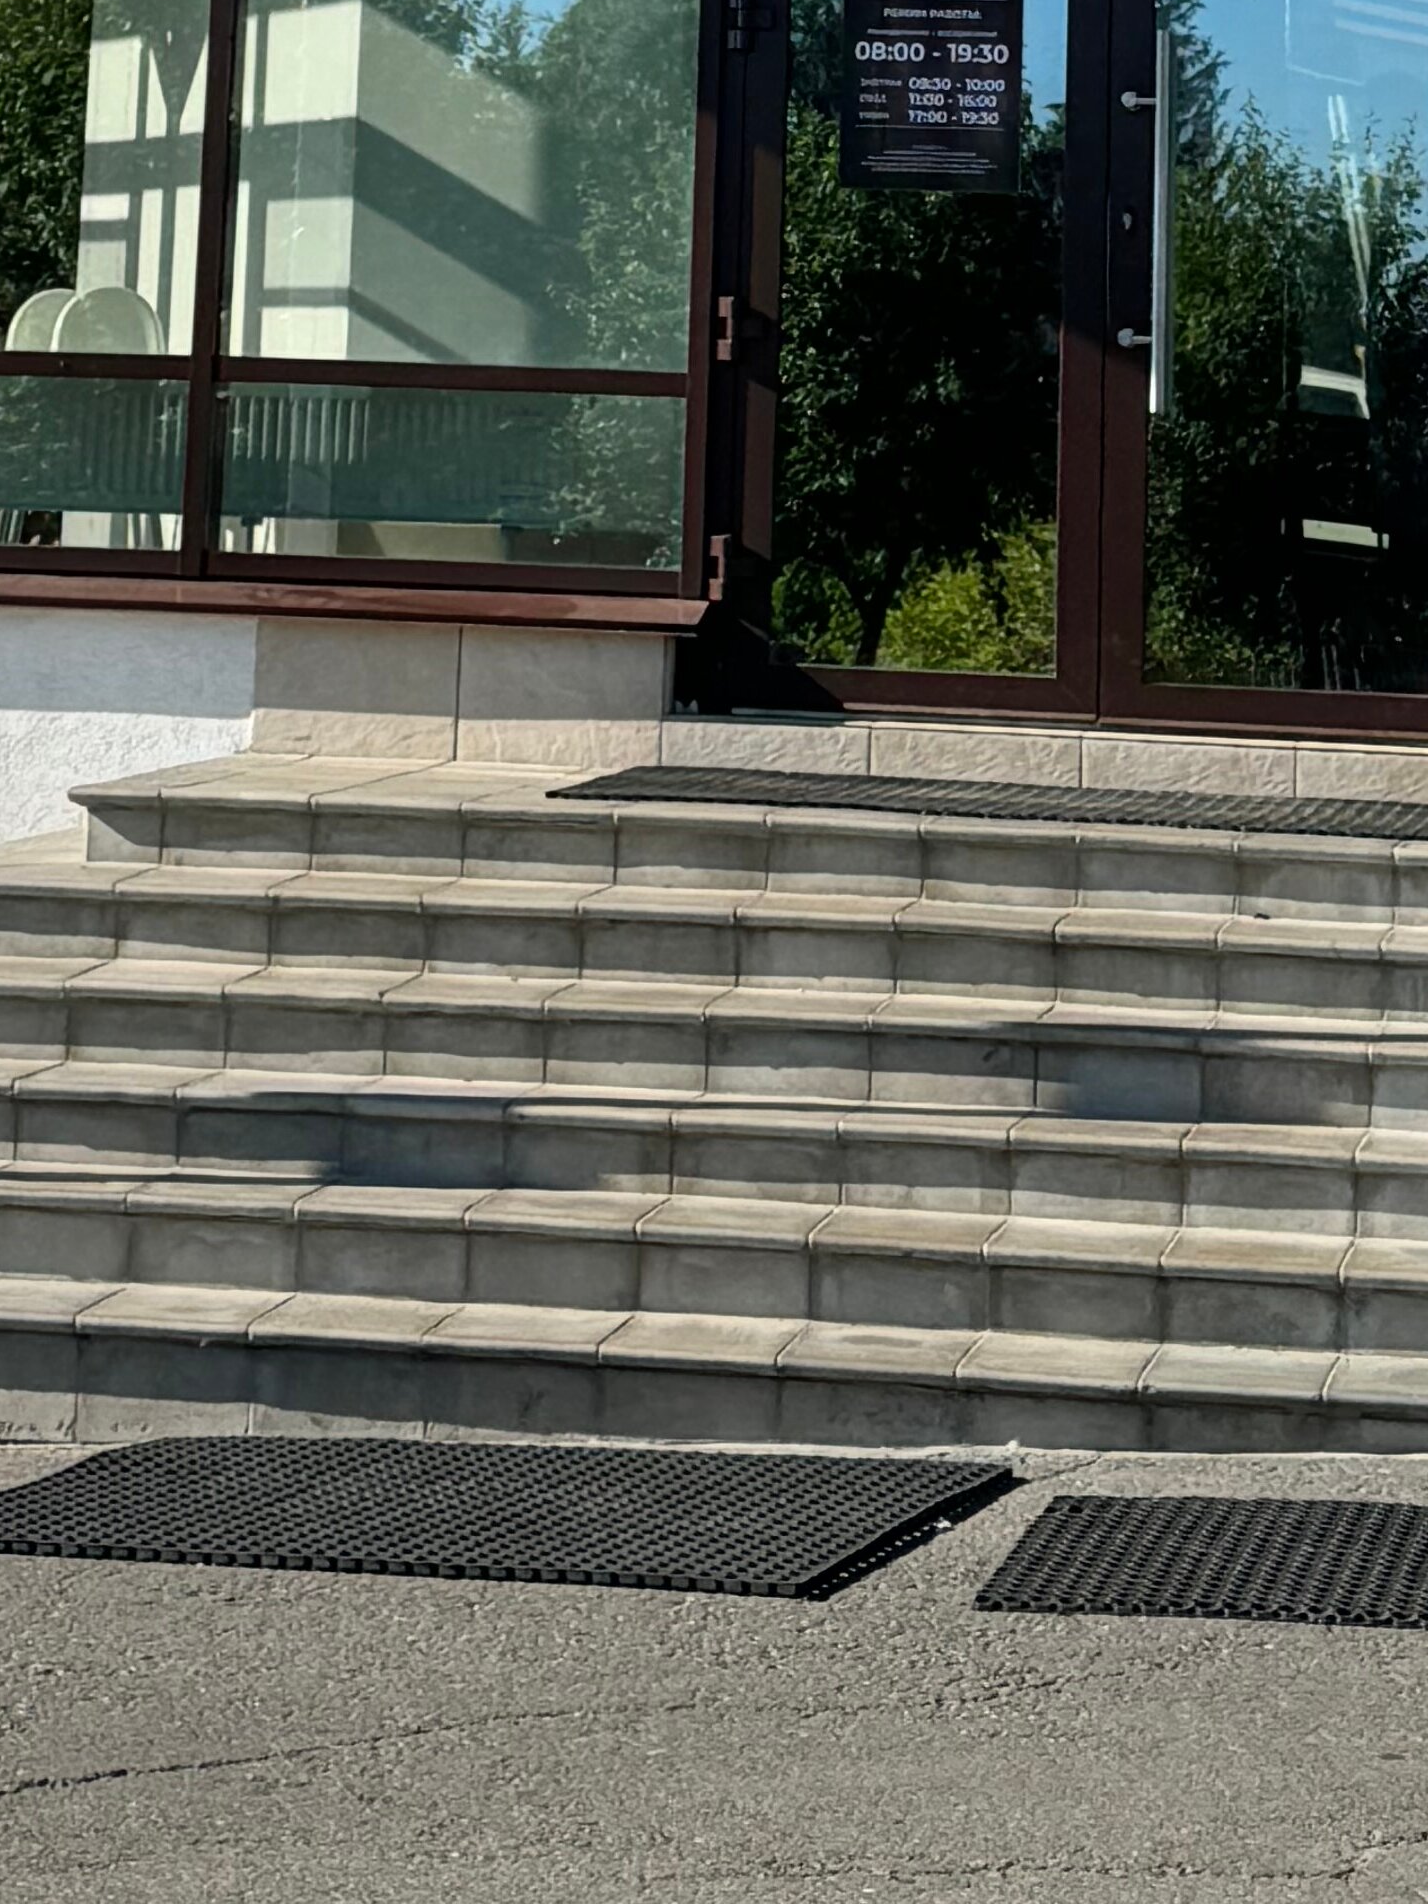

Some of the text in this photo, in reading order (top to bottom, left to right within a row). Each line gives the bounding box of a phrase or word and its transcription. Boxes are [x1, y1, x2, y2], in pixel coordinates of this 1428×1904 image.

[855, 41, 925, 62] 08:00
[947, 43, 1010, 64] 19:30
[965, 78, 1006, 92] 10:00
